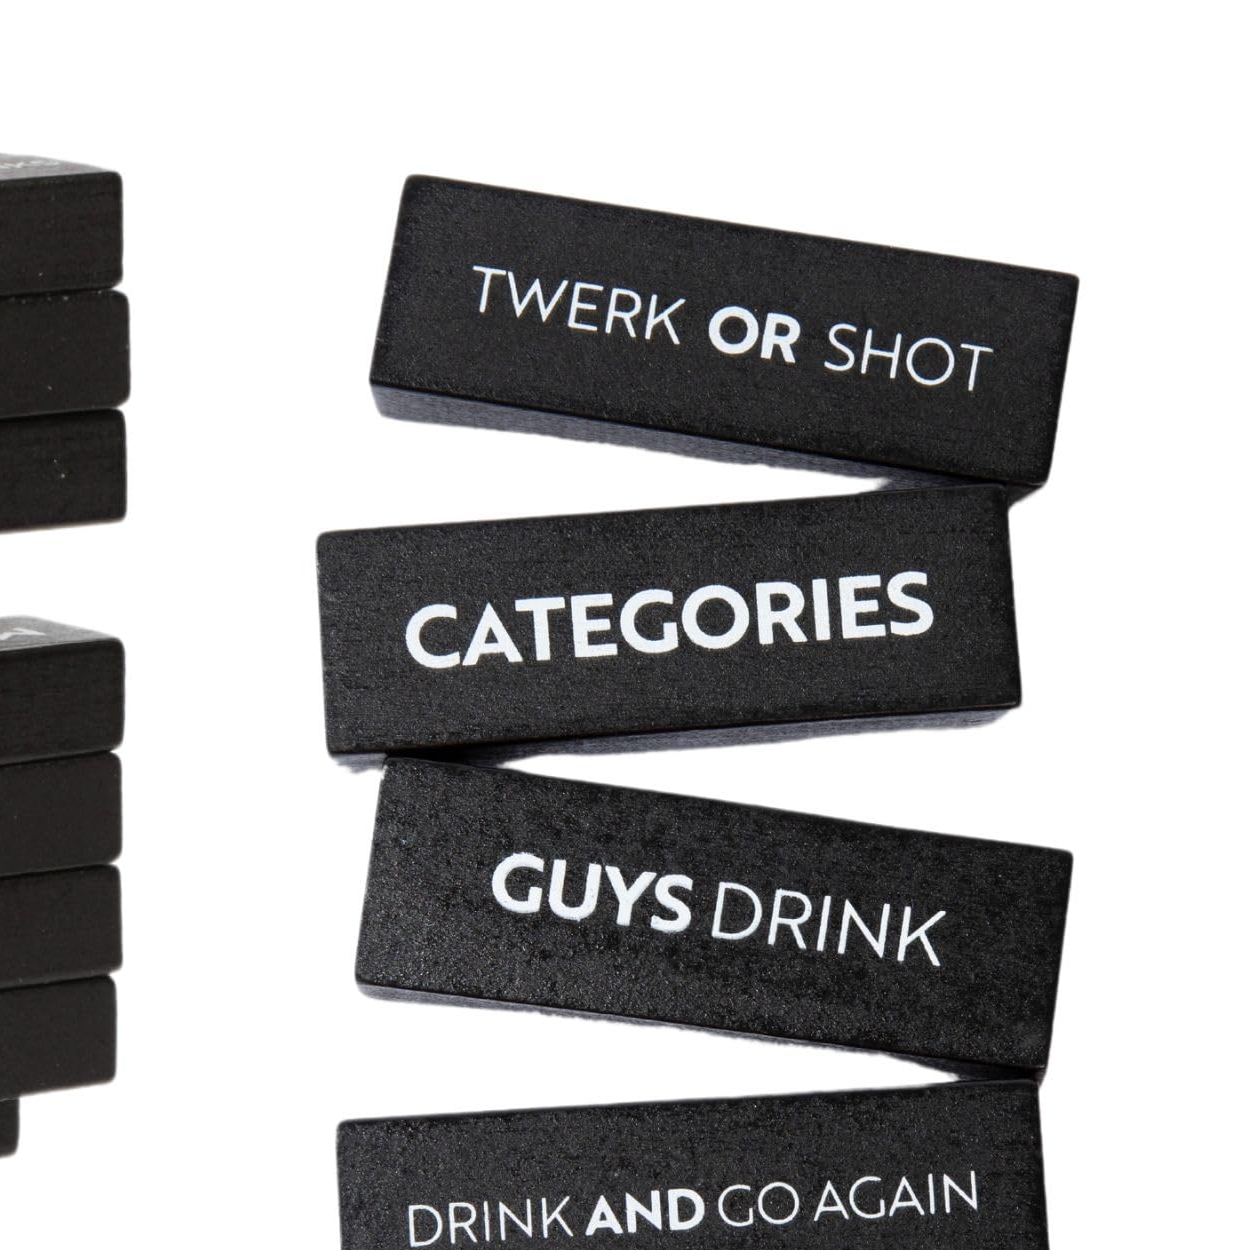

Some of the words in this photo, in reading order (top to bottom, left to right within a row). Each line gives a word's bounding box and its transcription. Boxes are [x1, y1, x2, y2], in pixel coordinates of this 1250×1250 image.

[472, 265, 686, 345] TWERK
[708, 305, 801, 364] OR
[823, 323, 994, 392] SHOT
[404, 570, 935, 670] CATEGORIES
[491, 851, 694, 934] GUYS
[711, 881, 947, 967] DRINK
[408, 1194, 574, 1248] DRINK
[585, 1188, 706, 1237] AND
[717, 1181, 800, 1228] GO
[813, 1170, 978, 1222] AGAIN
